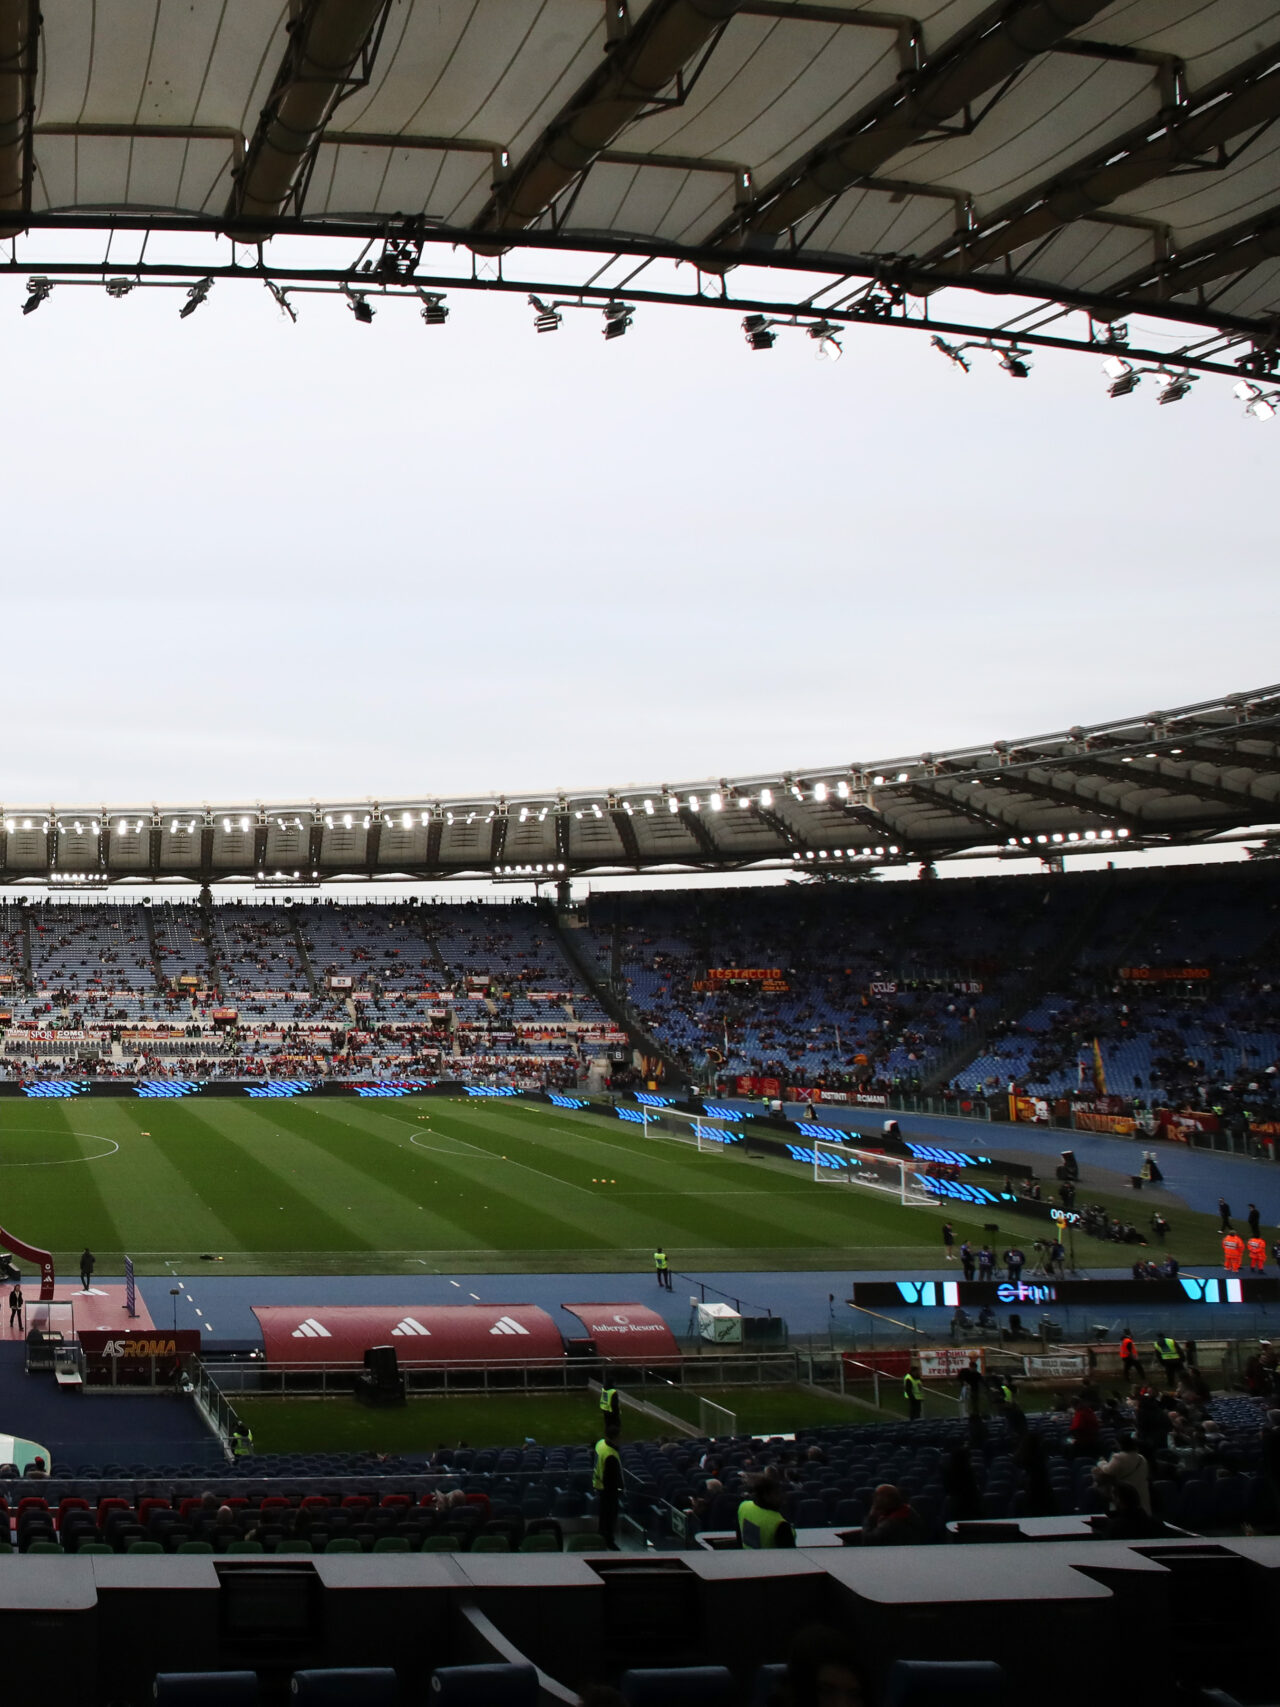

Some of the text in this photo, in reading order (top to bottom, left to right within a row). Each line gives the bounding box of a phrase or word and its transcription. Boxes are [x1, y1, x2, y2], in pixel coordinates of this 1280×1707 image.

[708, 968, 781, 979] TESTACCIO
[30, 1030, 54, 1040] SPQR
[615, 1051, 622, 1059] B
[855, 1093, 886, 1104] ROMANI
[592, 1324, 628, 1333] Auberge
